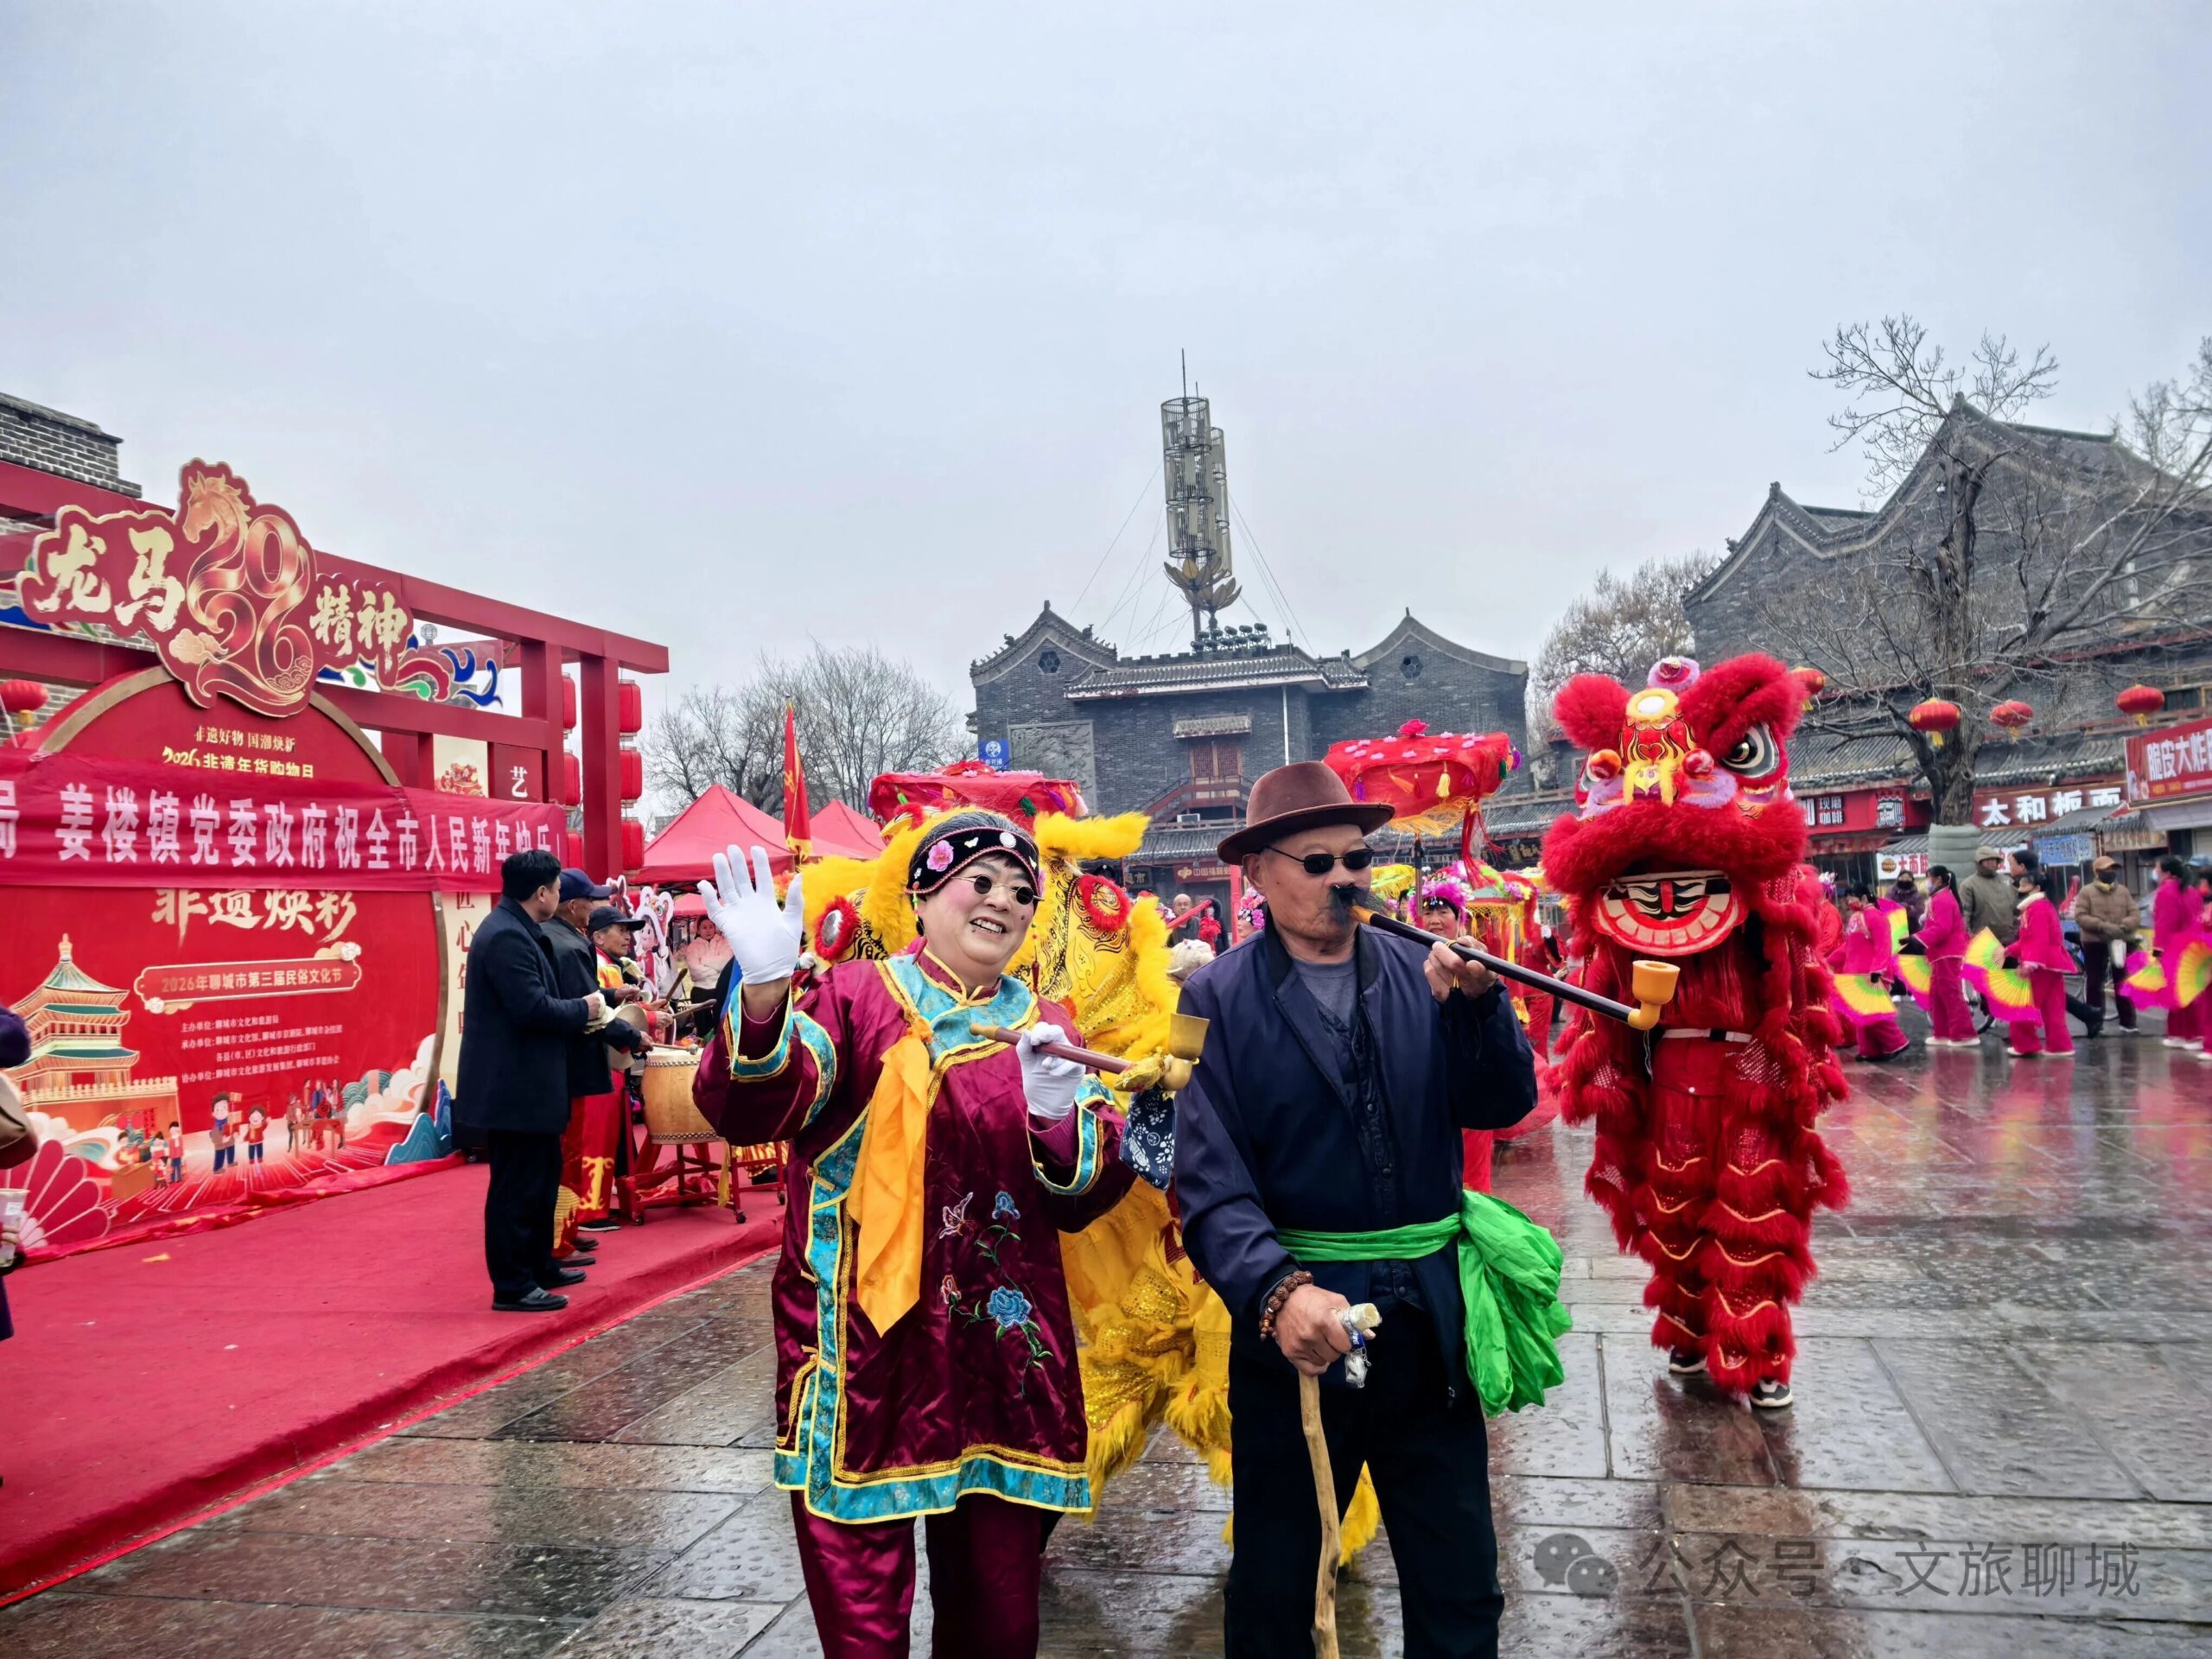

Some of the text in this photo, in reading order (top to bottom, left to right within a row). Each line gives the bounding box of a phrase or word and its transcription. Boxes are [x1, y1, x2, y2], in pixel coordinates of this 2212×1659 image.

[35, 524, 186, 632] 龙马
[309, 585, 409, 673] 精神
[194, 725, 296, 753] 非遗好物 国潮焕新
[509, 766, 528, 798] 艺
[1819, 810, 1843, 825] 咖啡
[151, 888, 358, 950] 非遗焕彩
[162, 968, 342, 994] 2026年聊城市第三届民俗文化节
